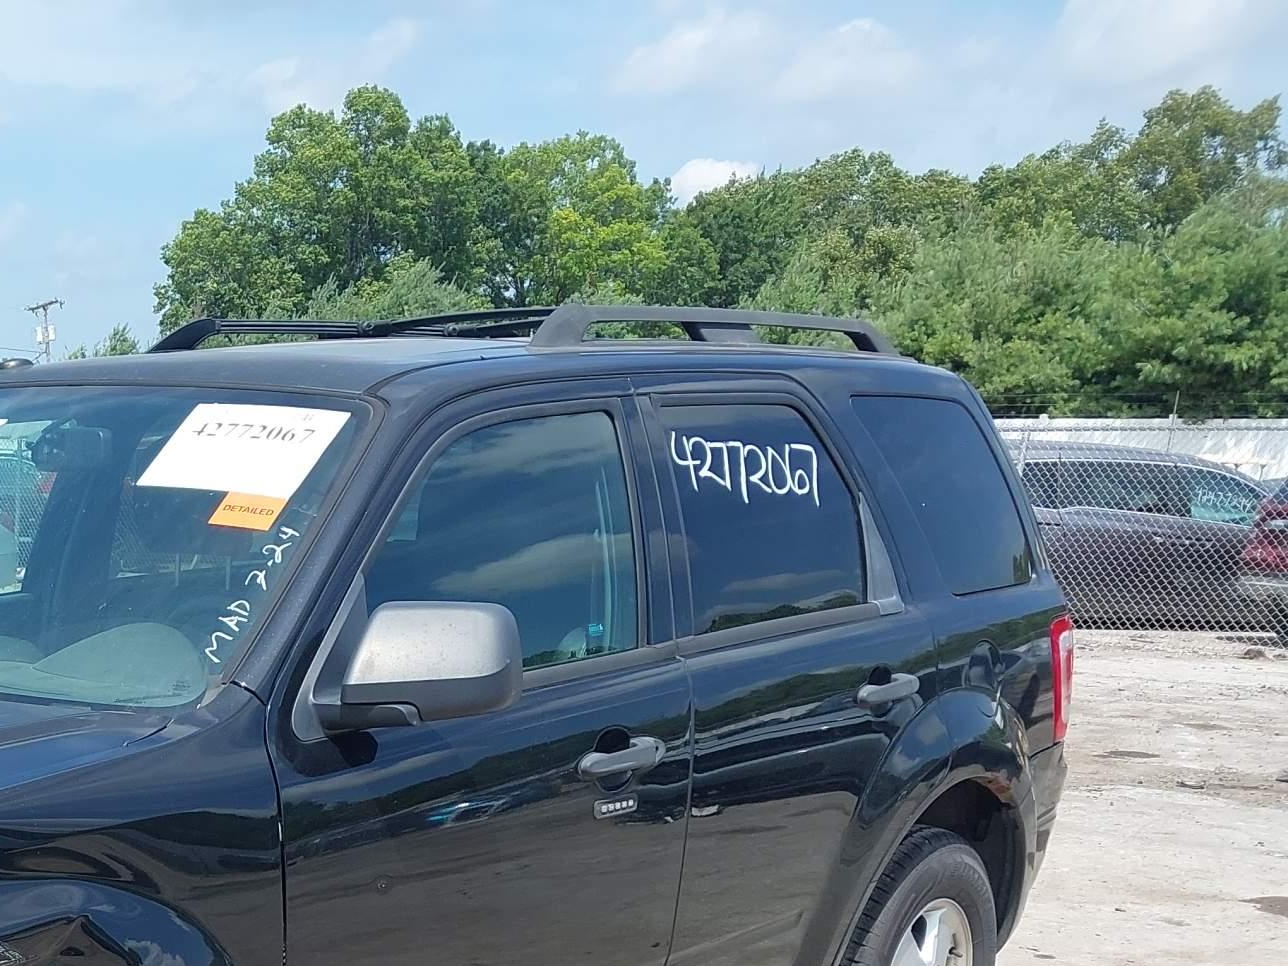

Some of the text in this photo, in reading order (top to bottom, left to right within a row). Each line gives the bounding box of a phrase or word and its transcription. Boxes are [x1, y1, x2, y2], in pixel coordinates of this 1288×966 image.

[191, 421, 316, 445] 42772067
[670, 430, 821, 508] 42772067
[222, 503, 275, 518] DETAILED
[204, 599, 251, 663] MAD
